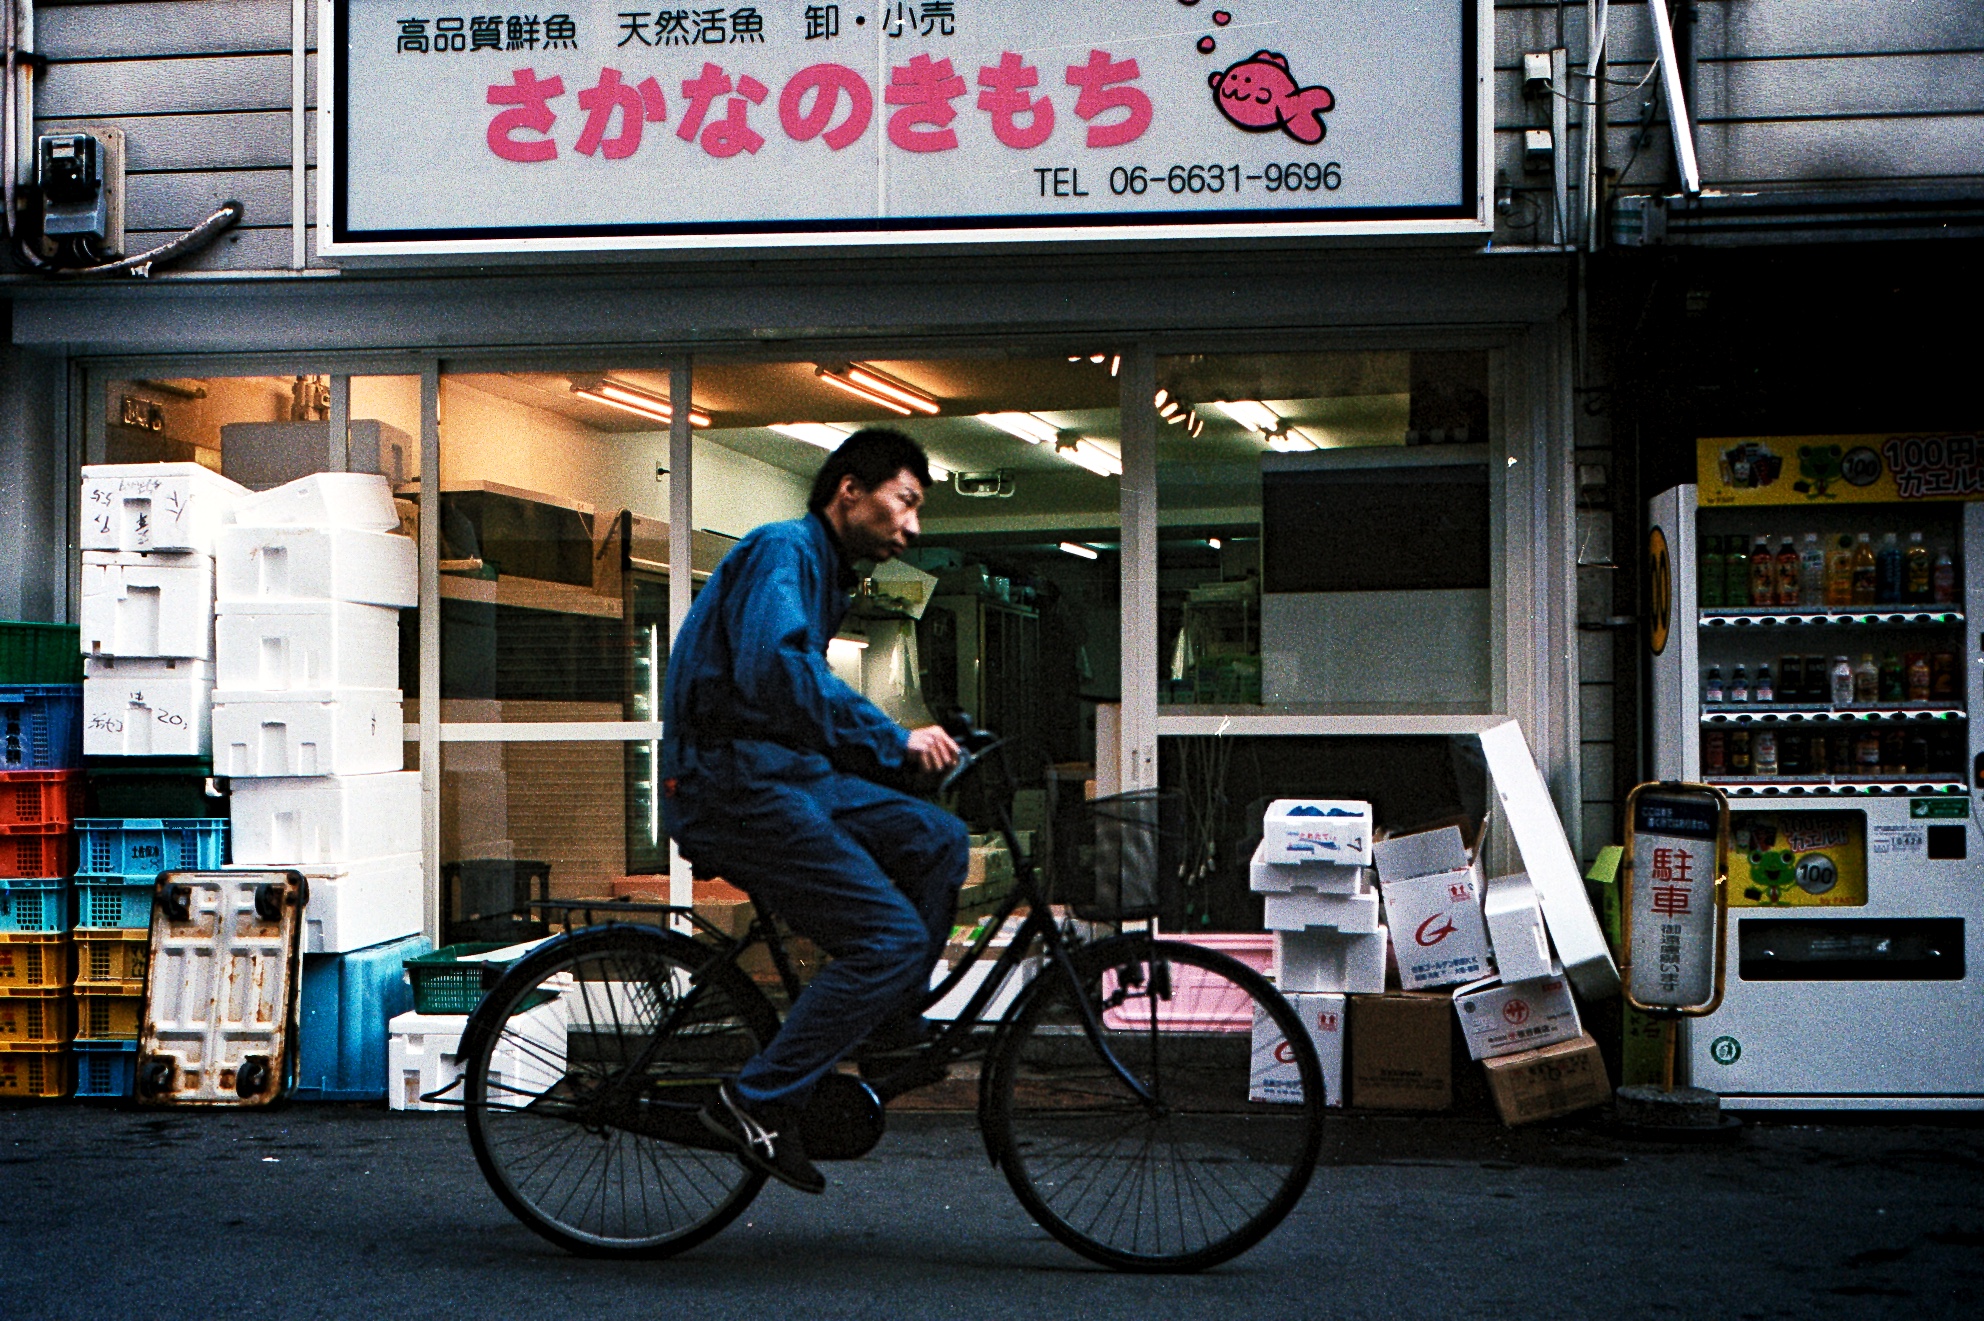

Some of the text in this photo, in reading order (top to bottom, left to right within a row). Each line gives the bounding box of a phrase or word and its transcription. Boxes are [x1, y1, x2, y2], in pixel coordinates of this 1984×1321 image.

[397, 1, 956, 53] 高品質鮮魚 天然活魚 卸・小売
[486, 50, 1153, 163] さかなのきもち
[1033, 162, 1342, 197] TEL 06-6631-9696
[1848, 457, 1877, 477] 100
[1651, 847, 1693, 919] 駐車
[1800, 865, 1832, 885] 100
